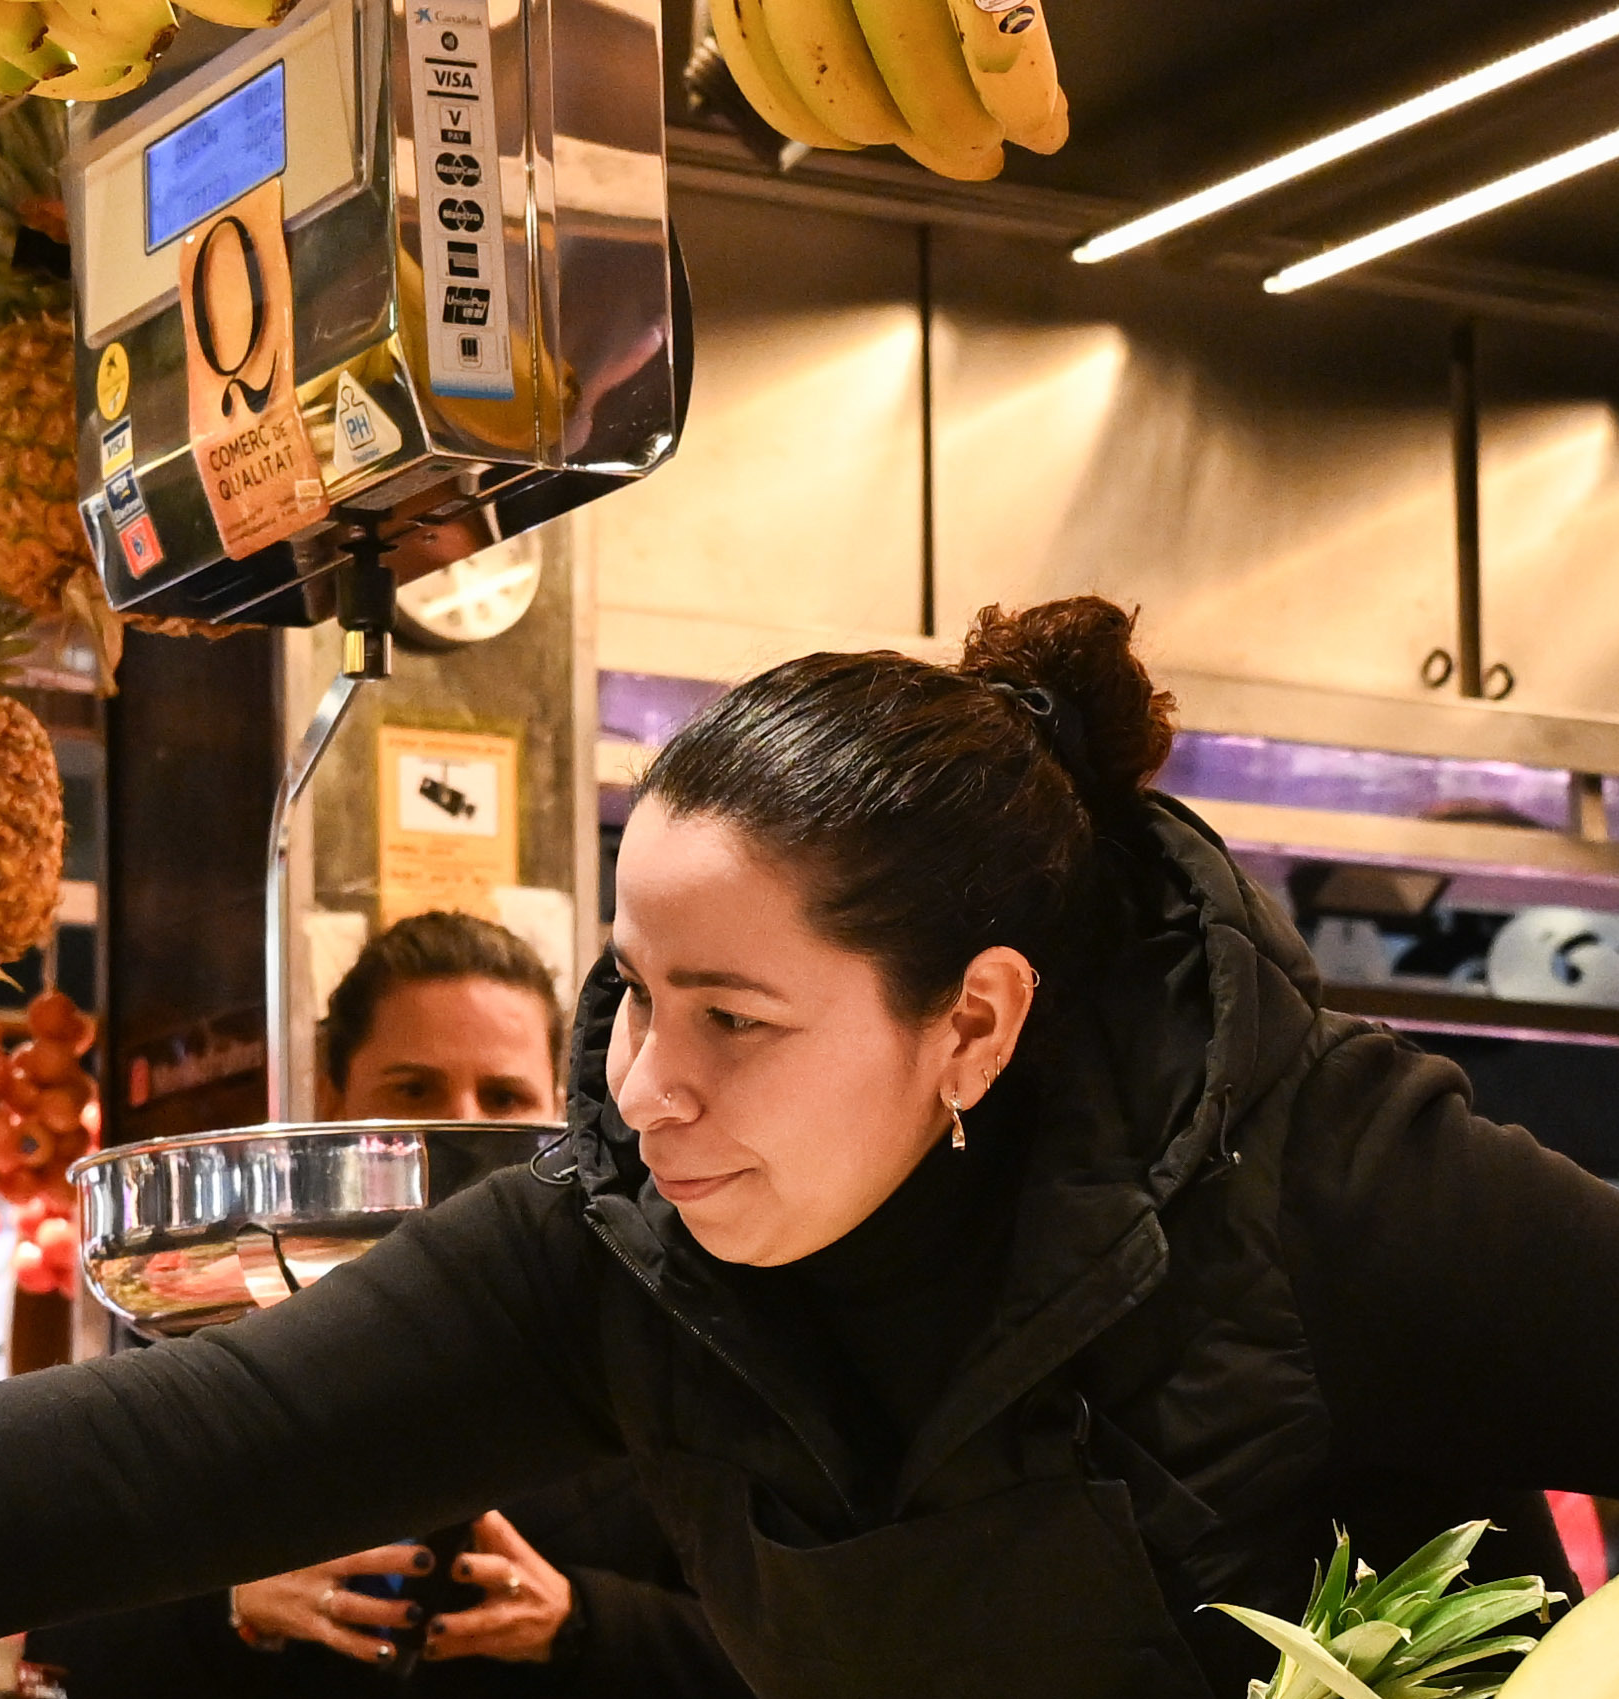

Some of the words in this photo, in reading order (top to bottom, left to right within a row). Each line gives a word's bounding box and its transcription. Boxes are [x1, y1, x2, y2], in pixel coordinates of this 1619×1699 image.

[433, 69, 473, 89] VISA
[448, 110, 462, 126] V
[192, 216, 278, 418] Q
[209, 426, 270, 472] COMERÇ
[271, 421, 288, 443] DE
[346, 415, 371, 443] PH
[218, 445, 295, 501] QUALITAT
